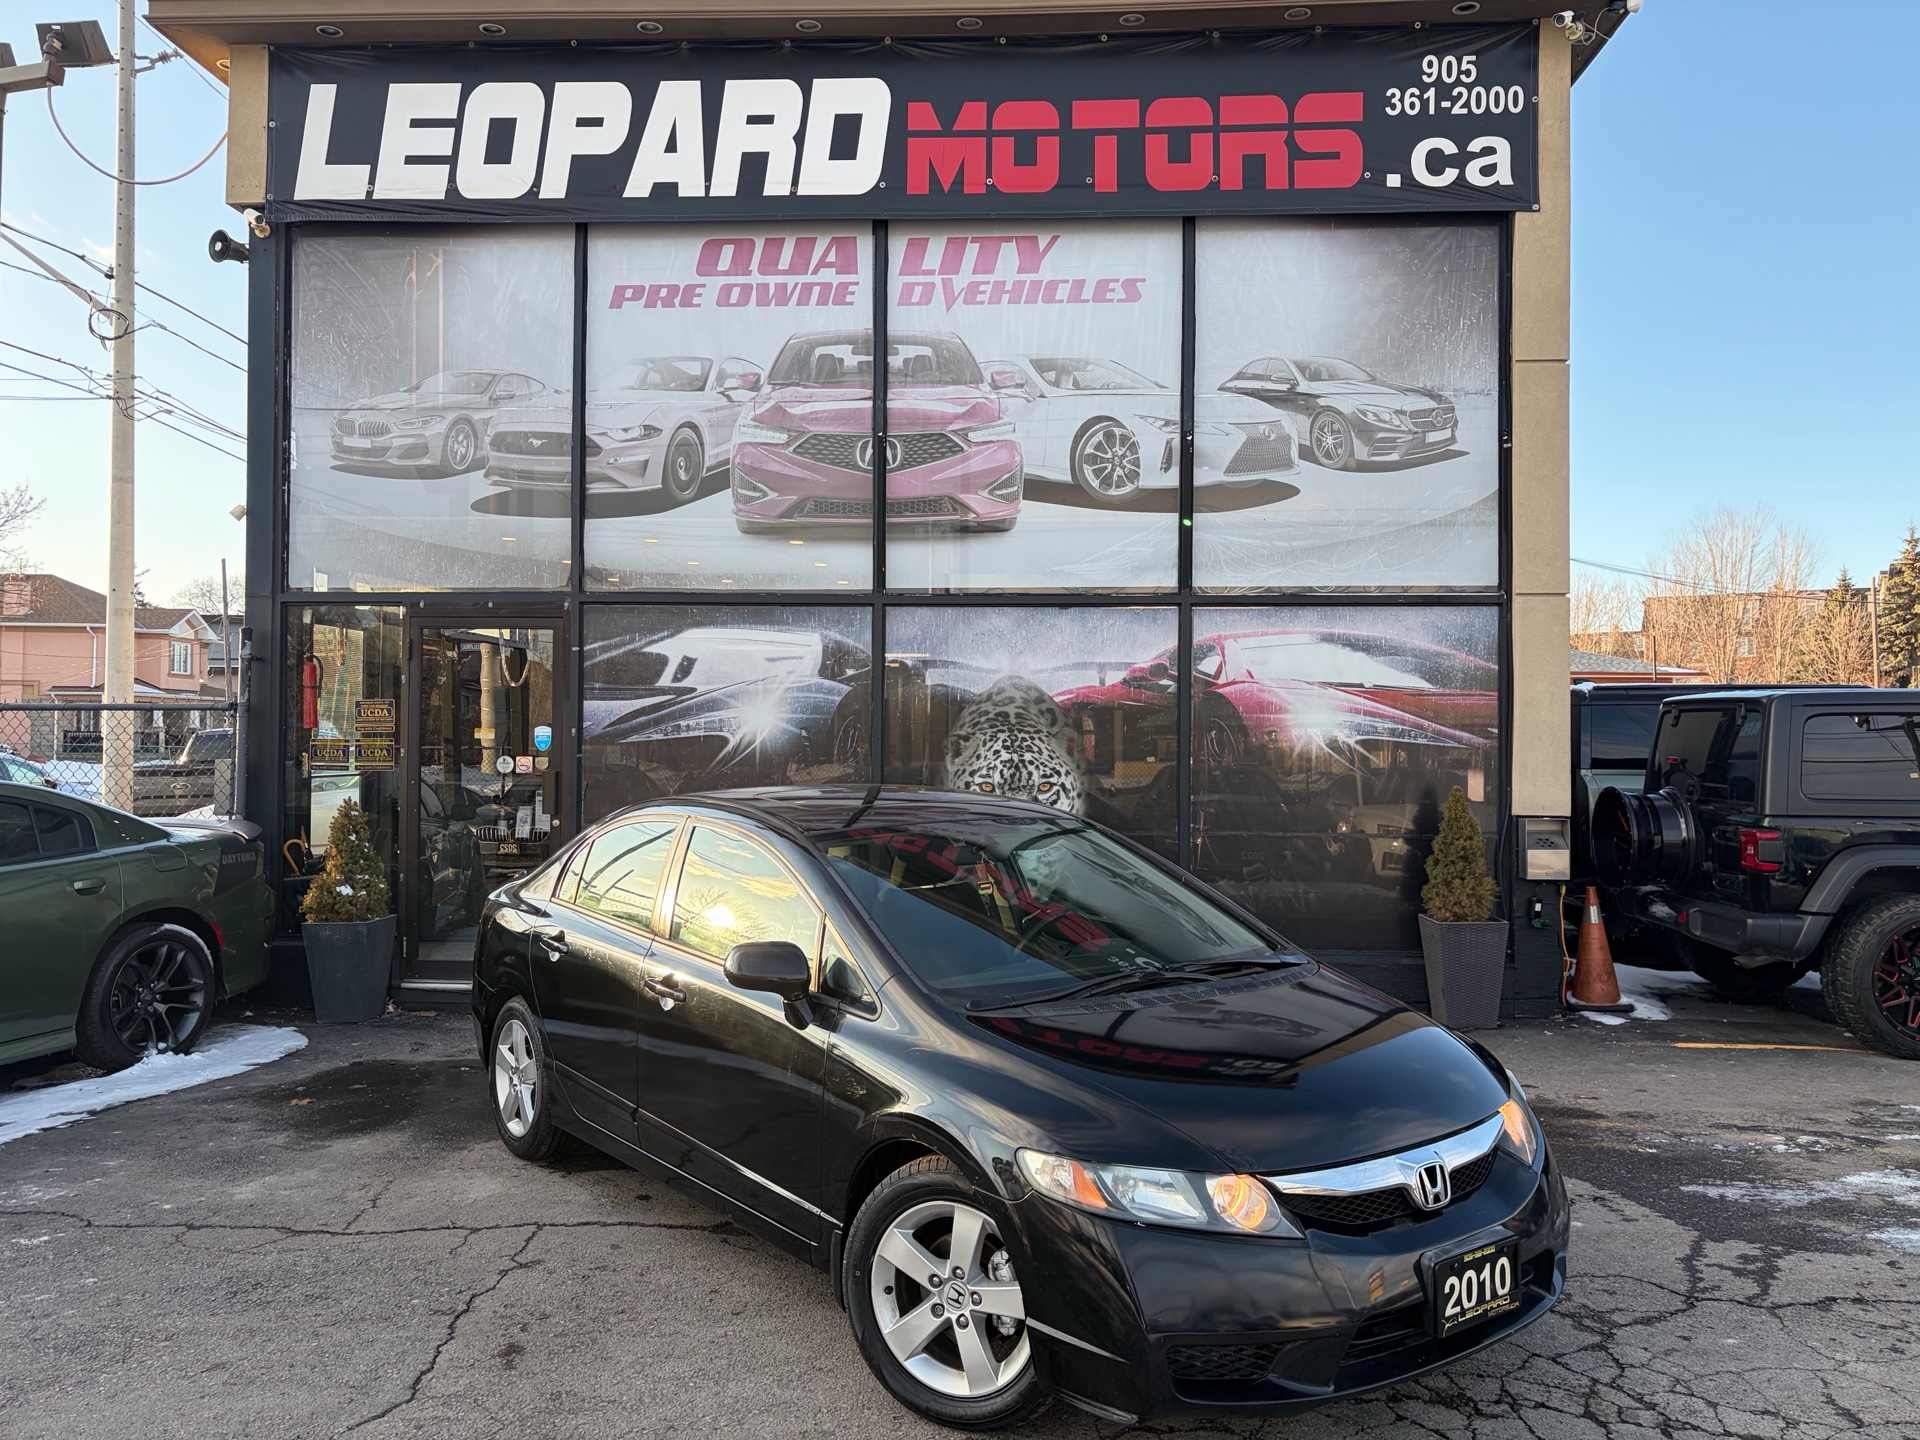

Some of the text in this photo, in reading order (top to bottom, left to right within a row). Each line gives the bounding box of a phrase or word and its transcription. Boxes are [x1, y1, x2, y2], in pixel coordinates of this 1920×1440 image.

[1421, 54, 1478, 84] 905
[1384, 84, 1526, 117] 361-2000
[293, 77, 1365, 201] LEOPARD MOTORS
[1385, 135, 1515, 188] .ca
[695, 234, 1062, 278] QUA LITY
[608, 283, 707, 310] PRE
[715, 281, 860, 308] OWNE
[361, 708, 389, 717] UCDA
[317, 749, 344, 757] UCDA
[361, 749, 388, 757] UCDA
[221, 851, 257, 865] DAYTONA
[1444, 1256, 1511, 1318] 2010
[1458, 1295, 1511, 1322] LEOPARD
